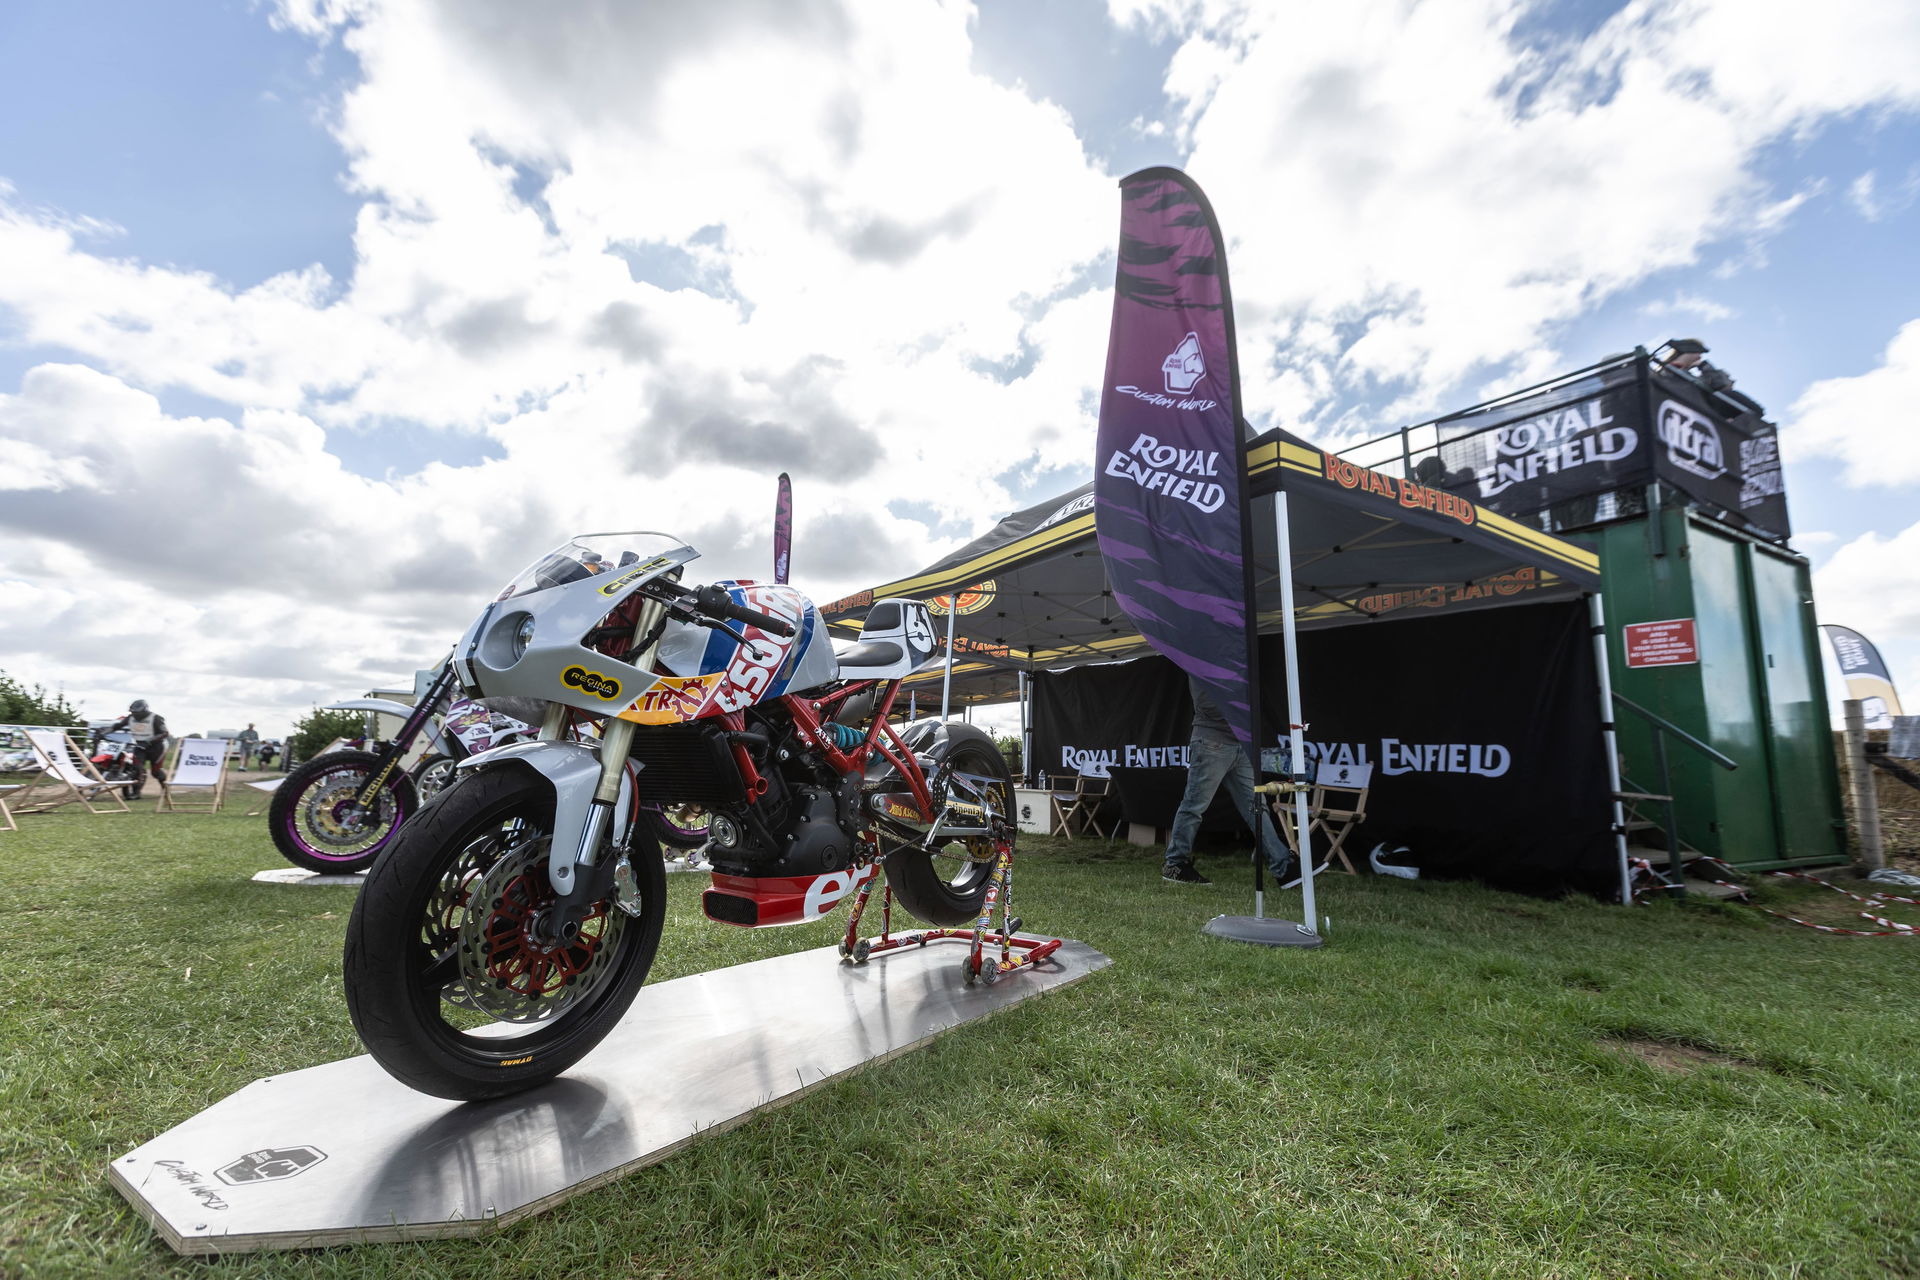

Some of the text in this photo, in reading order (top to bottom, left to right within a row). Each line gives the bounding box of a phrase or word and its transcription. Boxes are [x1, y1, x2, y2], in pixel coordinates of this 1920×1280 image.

[1485, 399, 1614, 461] ROYAL
[1129, 433, 1219, 477] ROYAL
[1478, 426, 1639, 498] ENFIELD
[1105, 450, 1226, 514] ENFIELD
[1324, 451, 1475, 525] ROYAL ENFIELD
[571, 672, 612, 692] REGINA
[629, 689, 674, 712] TR
[1062, 744, 1190, 771] ROYAL ENFIEL
[1381, 738, 1511, 778] ENFIELD
